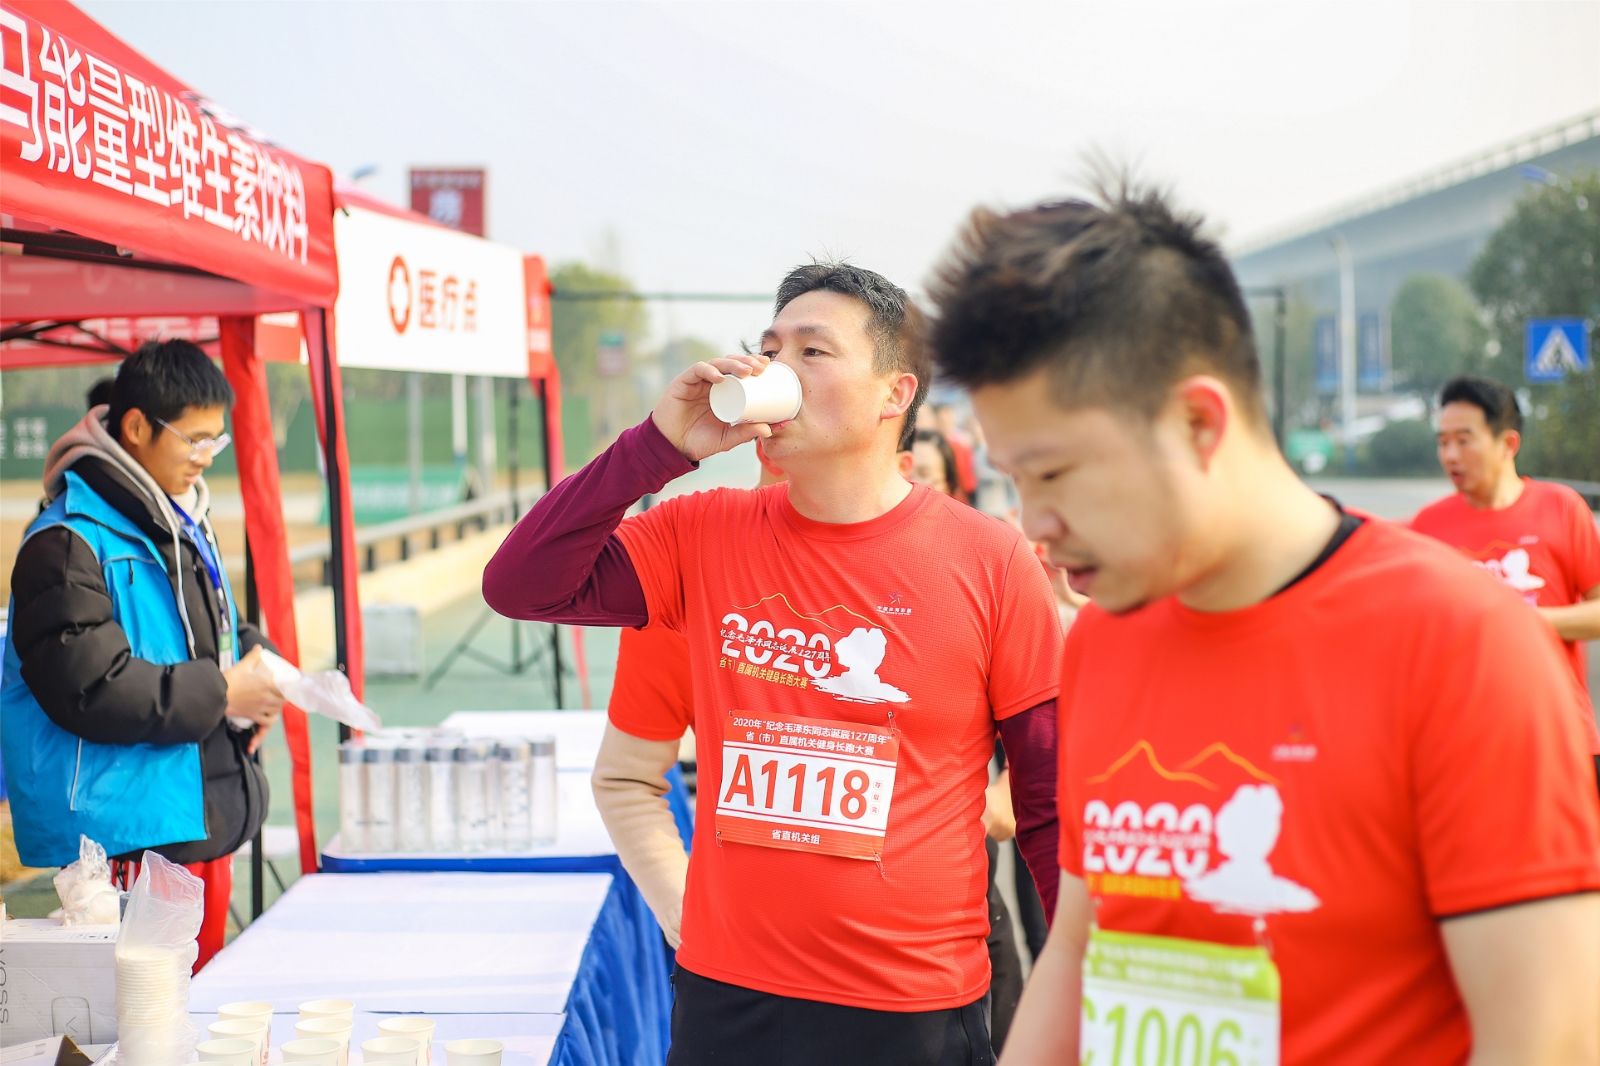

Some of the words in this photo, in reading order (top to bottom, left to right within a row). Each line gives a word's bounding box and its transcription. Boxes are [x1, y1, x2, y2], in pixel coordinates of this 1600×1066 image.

[419, 270, 476, 332] 医疗点
[721, 613, 832, 679] 2020
[724, 754, 870, 820] A1118
[772, 829, 820, 845] 省直机关组
[1084, 800, 1213, 877] 2020
